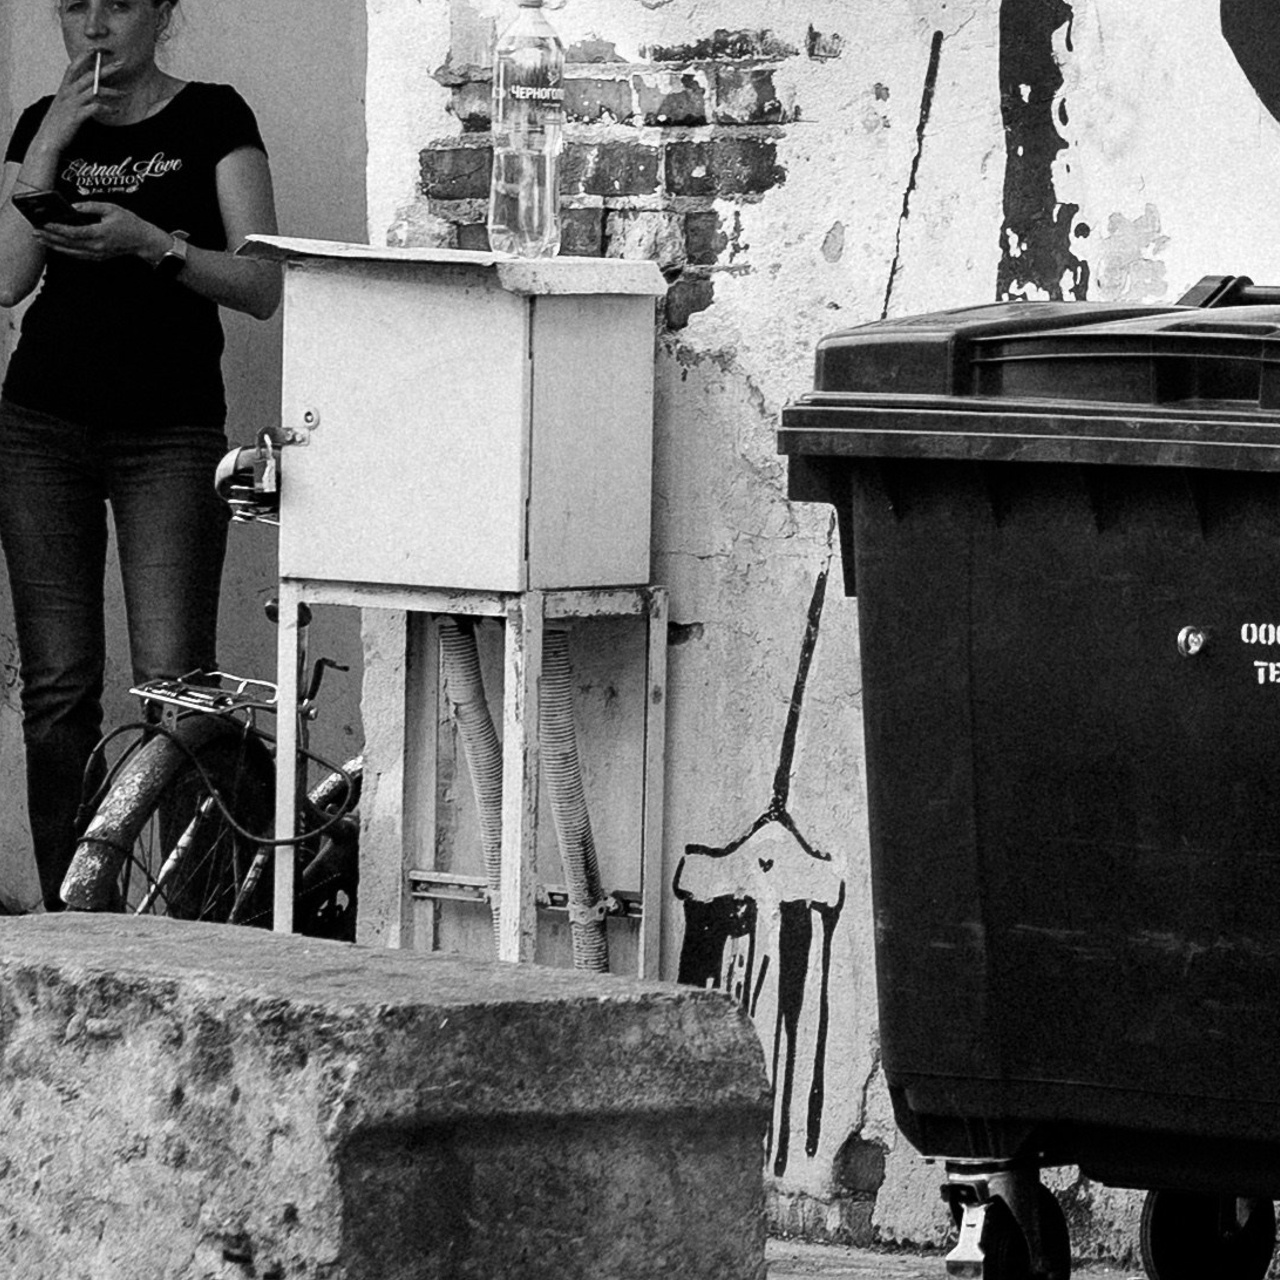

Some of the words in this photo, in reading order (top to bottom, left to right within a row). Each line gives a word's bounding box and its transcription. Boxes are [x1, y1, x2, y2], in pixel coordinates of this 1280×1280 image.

[511, 85, 564, 100] ЧЕРНОГО
[61, 156, 132, 181] Eternal
[133, 152, 183, 177] Love
[76, 174, 145, 186] DEVOTION
[1241, 623, 1280, 645] ОО
